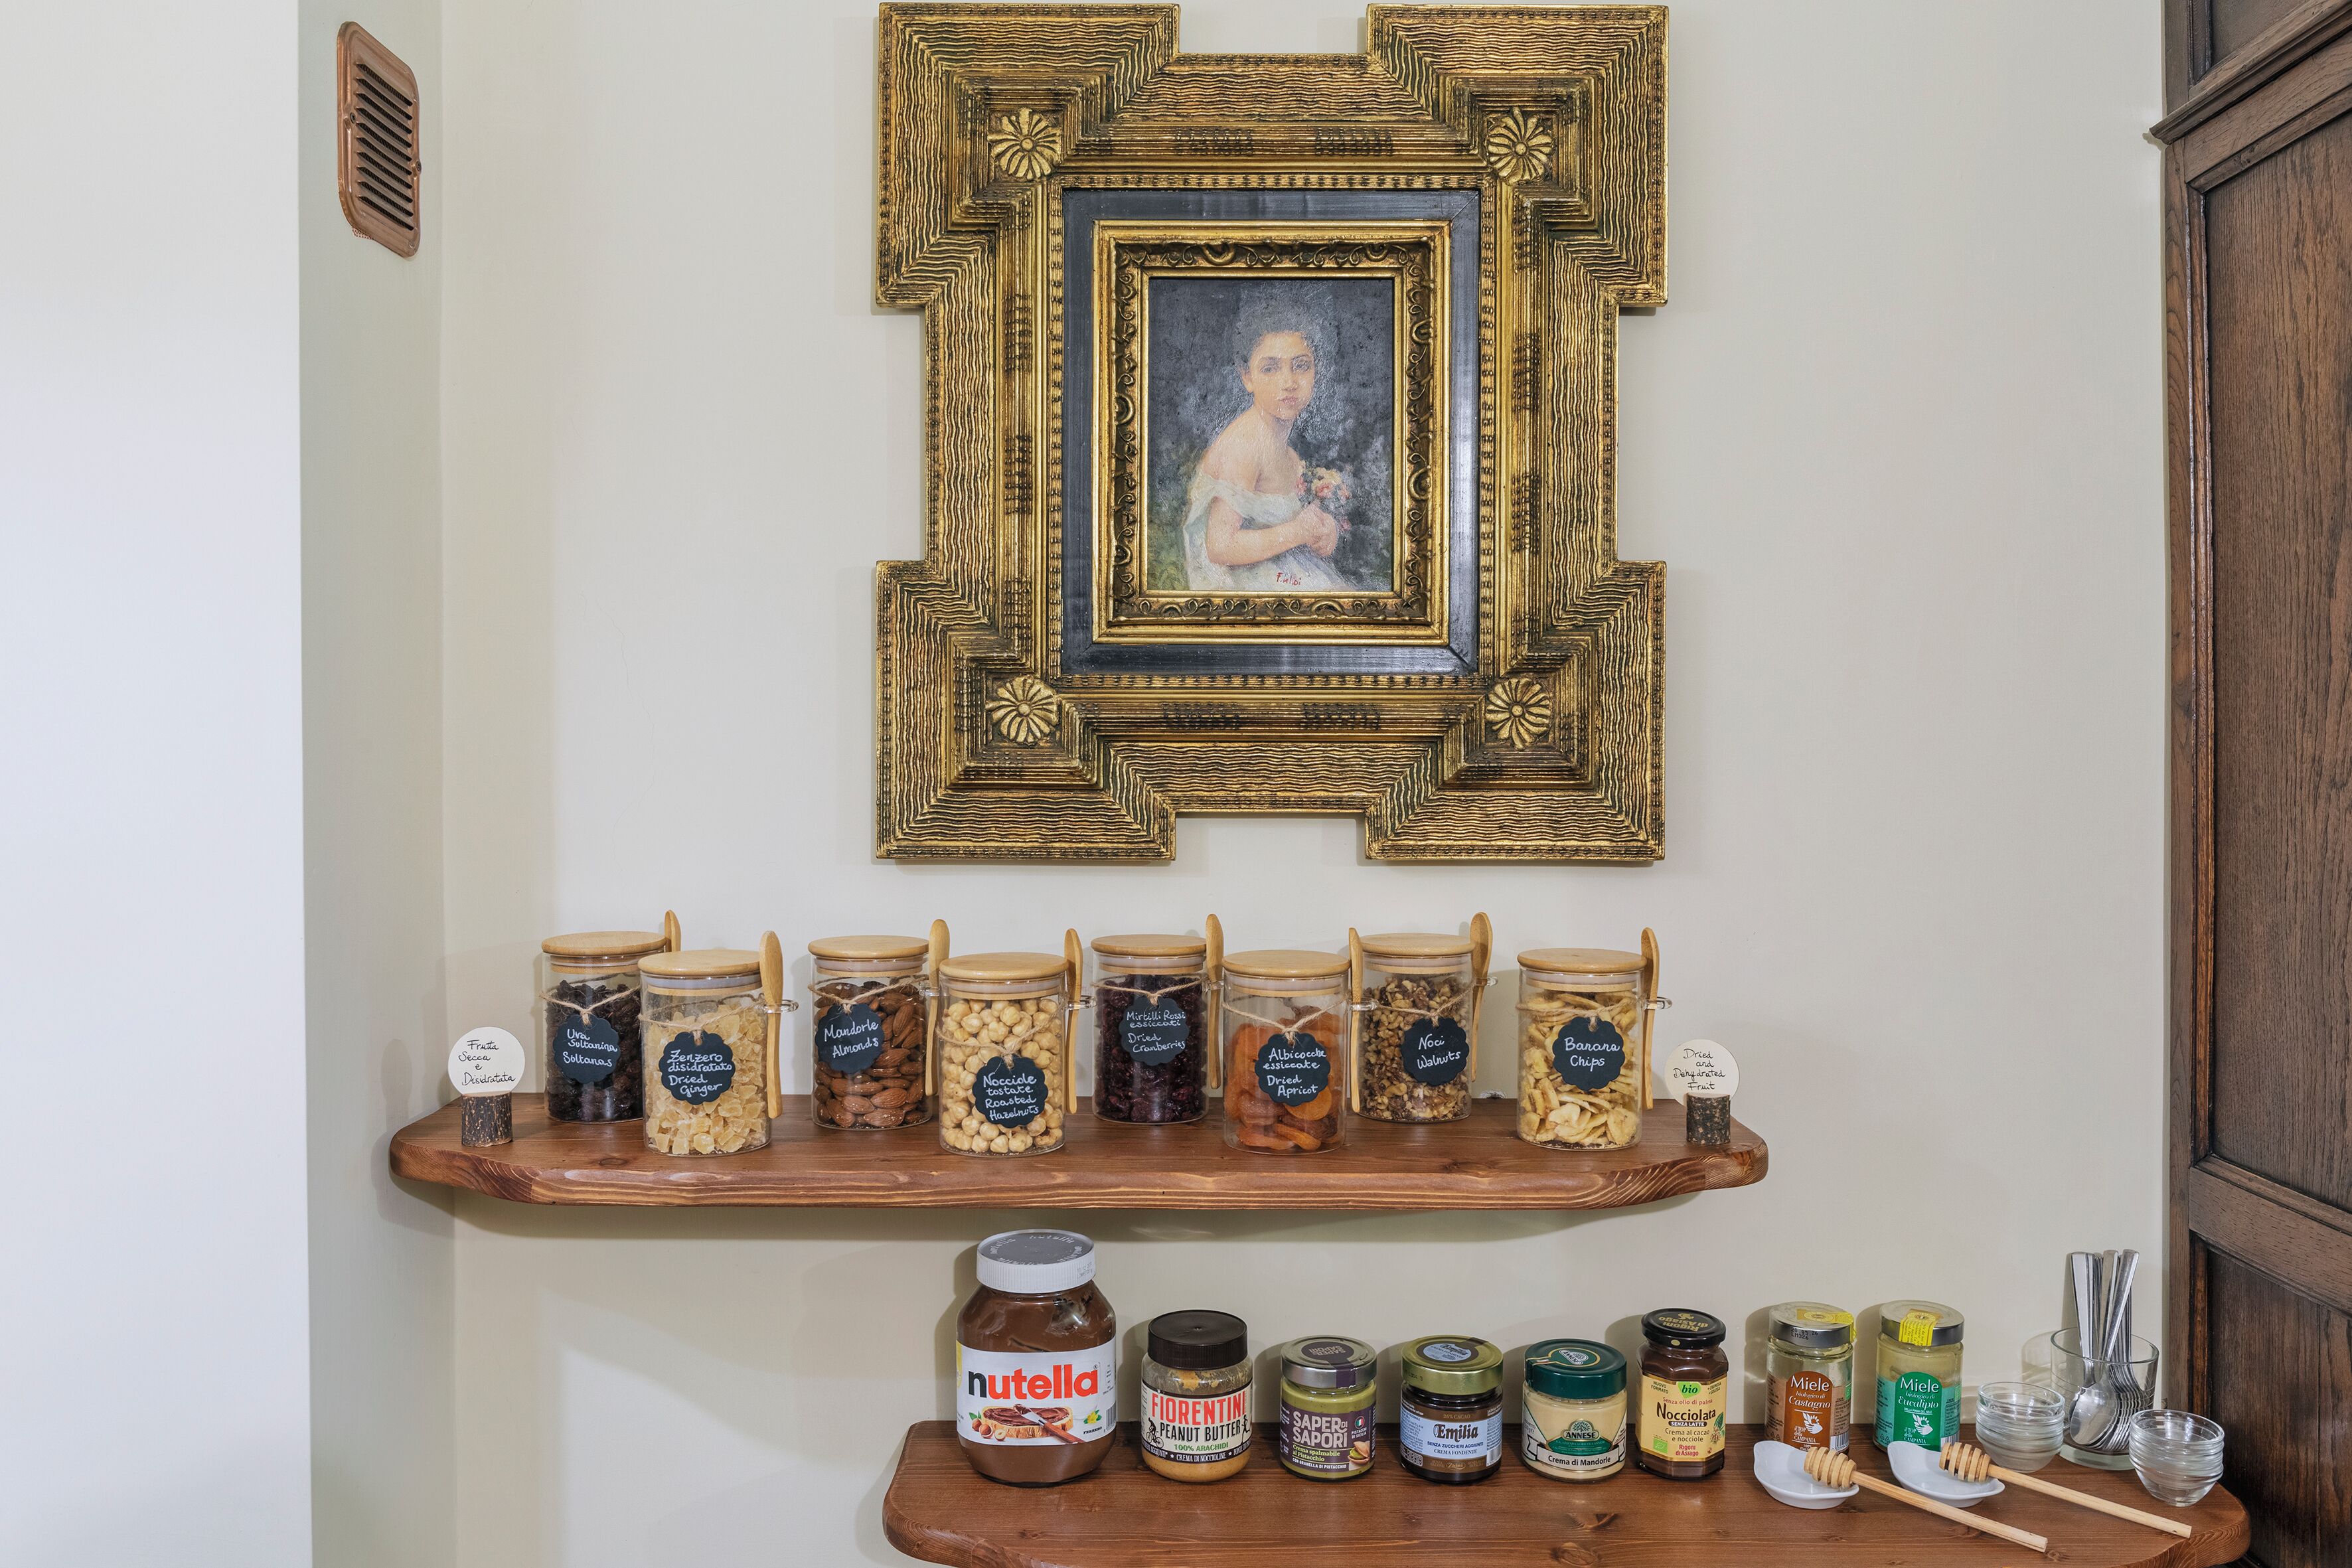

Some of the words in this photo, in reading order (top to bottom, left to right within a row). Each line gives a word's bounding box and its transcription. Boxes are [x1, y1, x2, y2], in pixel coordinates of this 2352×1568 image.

[1127, 1010, 1161, 1020] Mirtilli
[1164, 1010, 1186, 1020] Rossi
[824, 1018, 879, 1042] Mandorle
[1129, 1020, 1181, 1028] essiccati
[1127, 1032, 1162, 1044] Dried
[1418, 1033, 1445, 1050] Noci
[1564, 1036, 1620, 1052] Banana
[568, 1039, 618, 1052] Sultanina
[832, 1037, 879, 1058] Almonds
[1133, 1040, 1186, 1052] Cranberries
[458, 1051, 491, 1061] Secca
[666, 1049, 723, 1063] Zenzero
[1268, 1048, 1327, 1061] Albicocche
[1417, 1051, 1461, 1069] Walnuts
[1683, 1048, 1713, 1059] Dried
[668, 1062, 732, 1072] disidratato
[1263, 1059, 1320, 1069] essiccate
[1570, 1055, 1605, 1072] Chips
[461, 1071, 516, 1086] Disidratata
[668, 1074, 708, 1086] Dried
[983, 1072, 1037, 1088] Nocciole
[1267, 1074, 1302, 1086] Dried
[1673, 1067, 1726, 1081] Dehydrated
[680, 1083, 723, 1097] Ginger
[986, 1085, 1034, 1096] tostate
[1277, 1084, 1318, 1099] Apricot
[1687, 1081, 1715, 1091] Fruit
[985, 1095, 1037, 1109] Roasted
[989, 1105, 1040, 1121] Hazelnuts
[968, 1364, 1098, 1400] nutella
[1651, 1385, 1669, 1393] FORMATO
[1682, 1385, 1698, 1393] bio
[1790, 1375, 1830, 1391] Miele
[1900, 1376, 1939, 1393] Miele
[1152, 1391, 1245, 1425] FIORENTINI
[1788, 1395, 1831, 1411] Castagno
[1898, 1395, 1939, 1410] Eucalipto
[1656, 1401, 1716, 1421] Nocciolata
[1293, 1411, 1348, 1433] SAPER
[1083, 1426, 1103, 1435] FERRERO
[1160, 1422, 1200, 1443] PEANUT
[1205, 1419, 1241, 1441] BUTTER
[1293, 1426, 1348, 1448] SAPORI
[1433, 1423, 1478, 1443] Emilia
[1174, 1443, 1194, 1452] 100%
[1196, 1442, 1229, 1452] ARACHIDI
[1293, 1445, 1308, 1453] Crema
[1176, 1453, 1193, 1462] CREMA
[1200, 1452, 1227, 1462] NOCCIOLINE
[1298, 1452, 1325, 1462] Pistacchio
[1548, 1455, 1570, 1465] Crema
[1580, 1456, 1611, 1466] Mandorle
